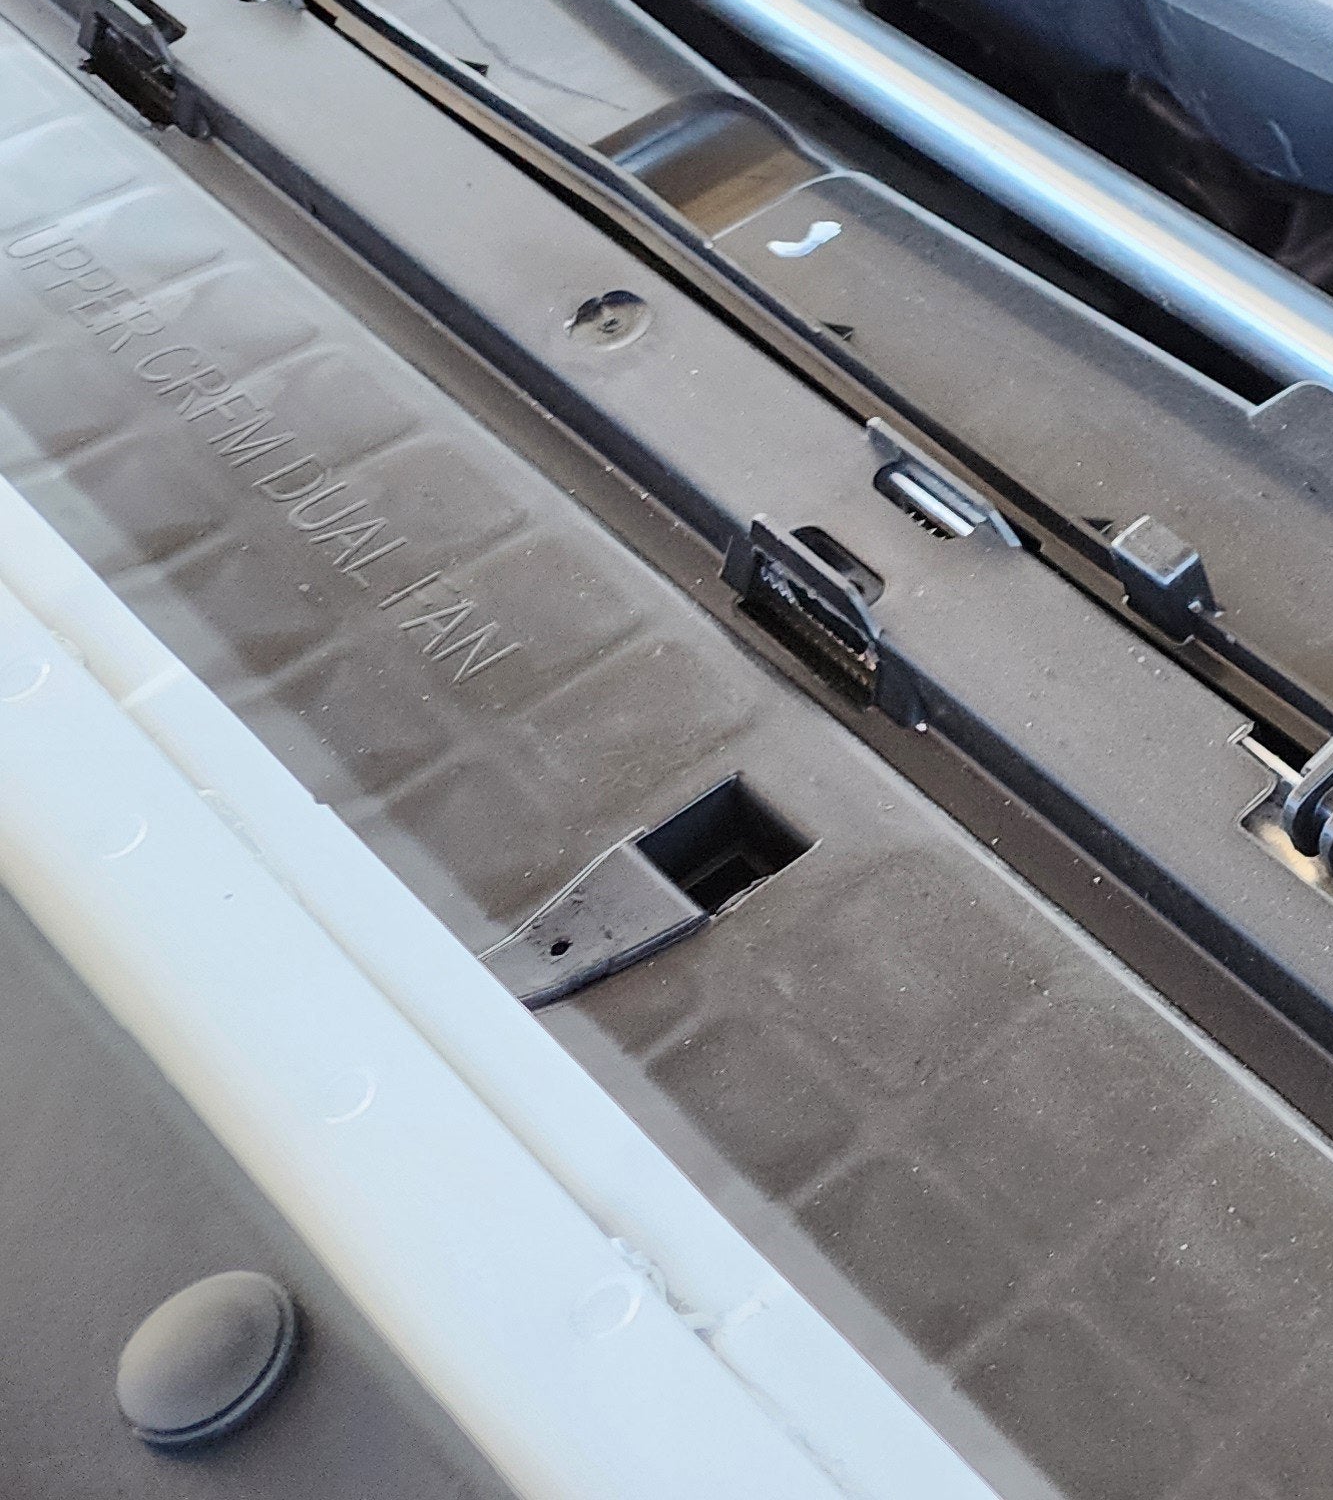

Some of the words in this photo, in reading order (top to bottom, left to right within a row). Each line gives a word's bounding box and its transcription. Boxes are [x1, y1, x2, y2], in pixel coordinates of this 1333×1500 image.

[6, 226, 166, 353] UPPER
[135, 345, 294, 468] CRFM
[253, 455, 406, 589] DUAL
[379, 570, 521, 684] FAN
